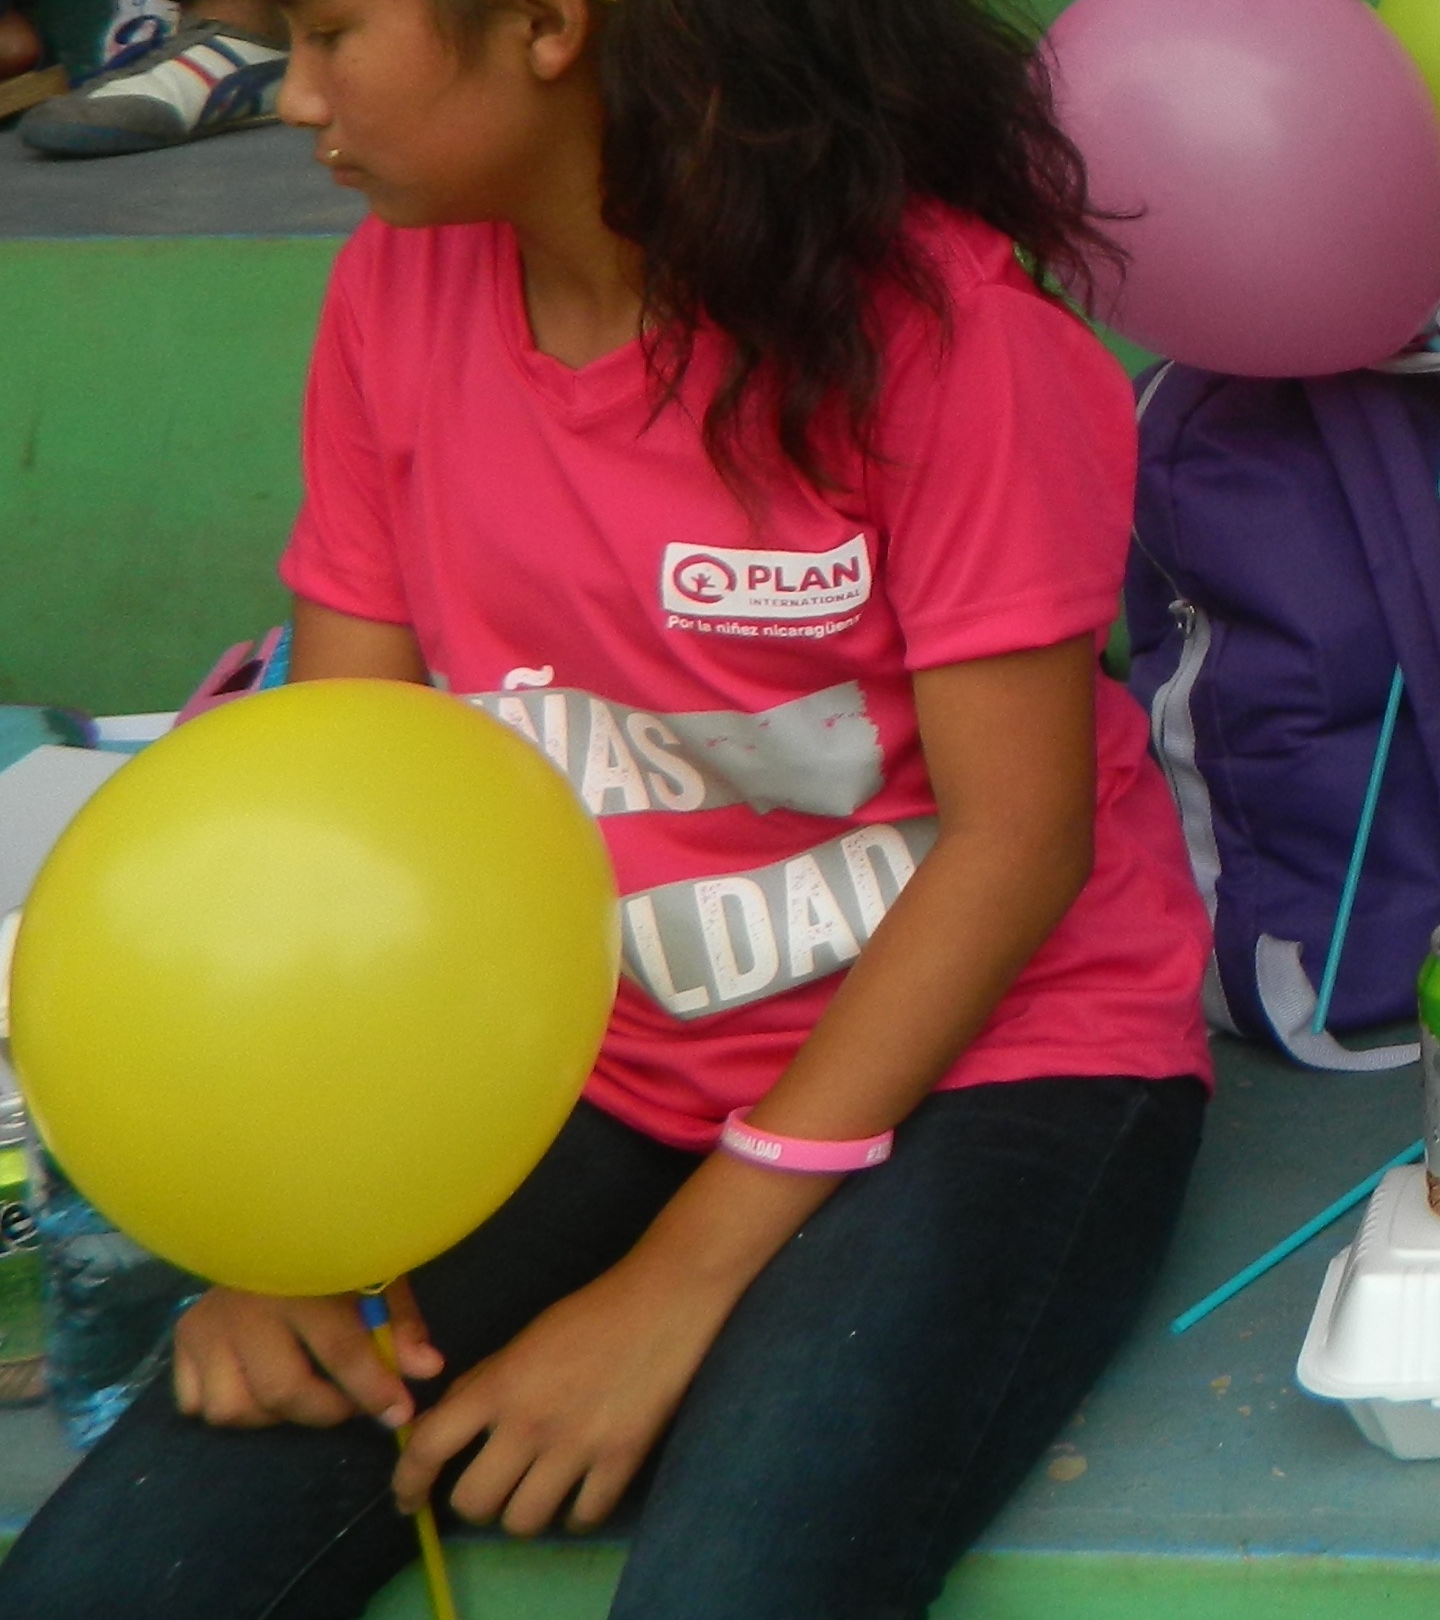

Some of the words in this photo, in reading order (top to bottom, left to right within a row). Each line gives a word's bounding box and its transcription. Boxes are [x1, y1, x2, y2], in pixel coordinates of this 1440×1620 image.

[747, 556, 861, 593] PLAN
[749, 589, 861, 607] INTERNATIONAL
[667, 615, 694, 629] Por
[697, 619, 712, 633] la
[715, 621, 759, 636] niñez
[626, 822, 916, 1014] LDAD
